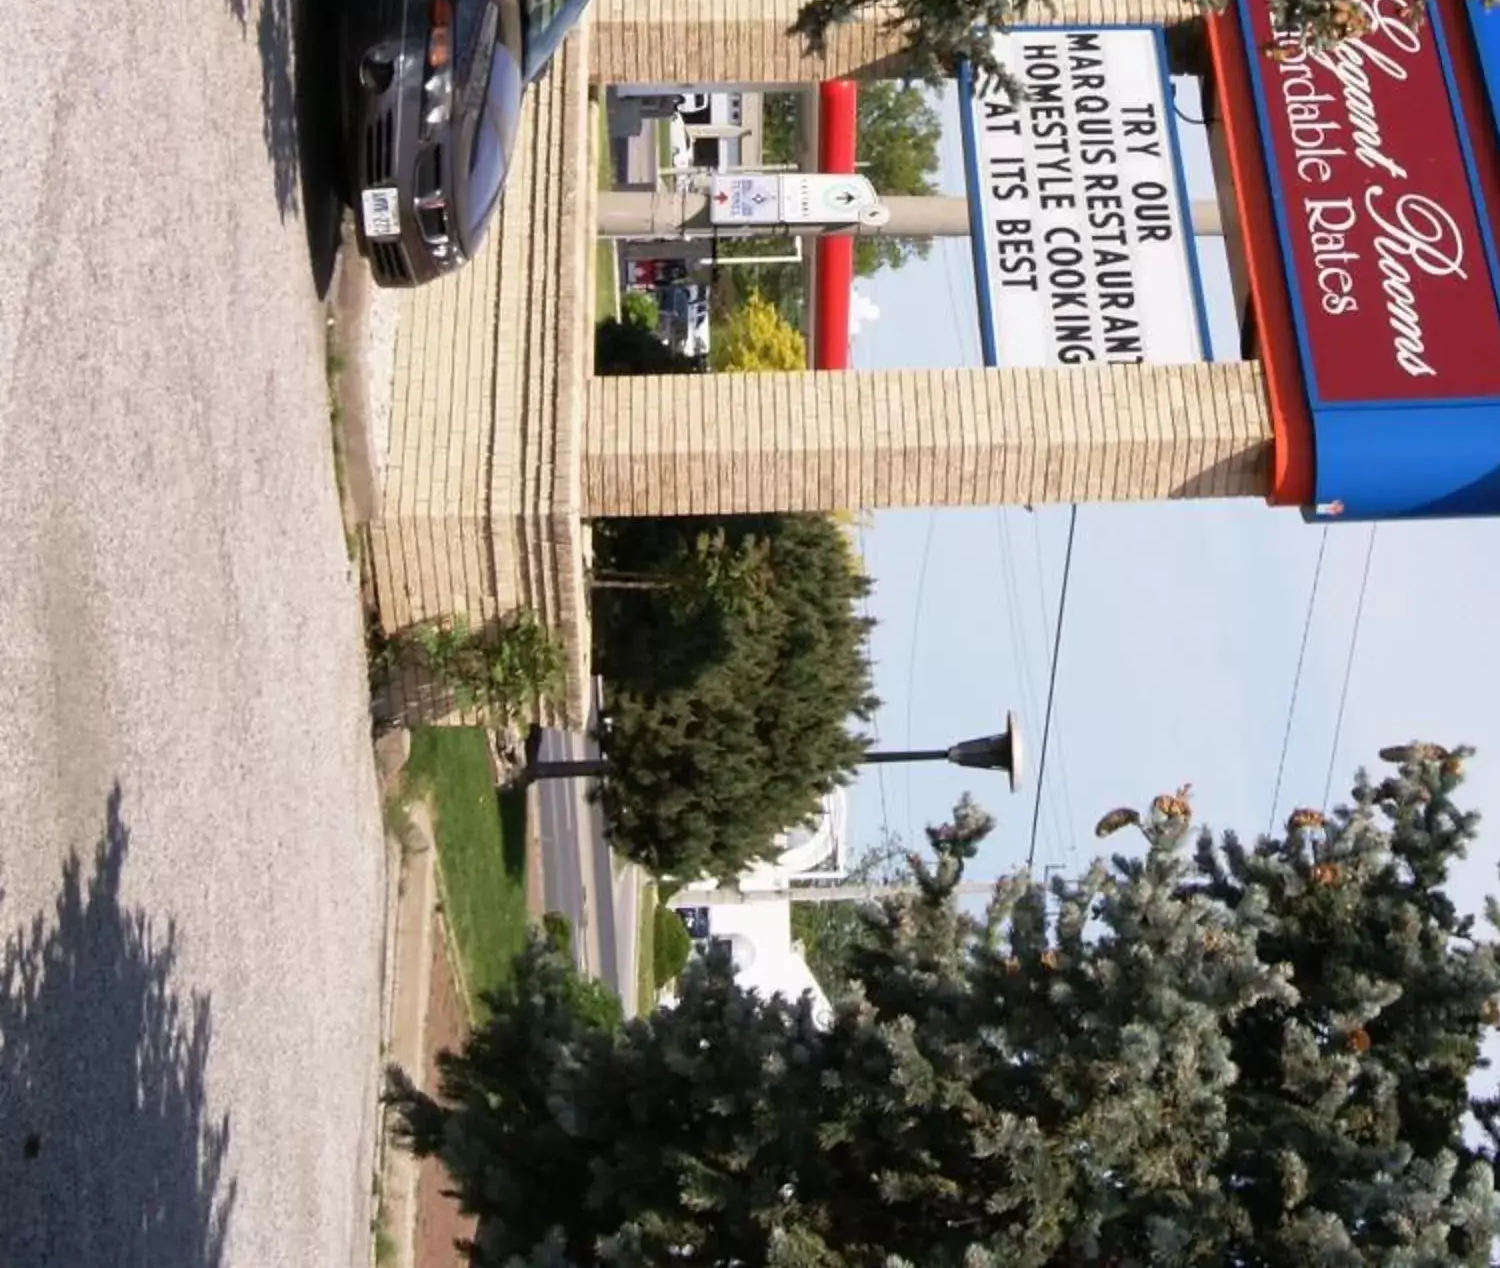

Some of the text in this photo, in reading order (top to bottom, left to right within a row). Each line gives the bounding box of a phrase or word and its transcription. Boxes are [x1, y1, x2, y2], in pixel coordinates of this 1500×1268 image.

[1066, 33, 1117, 164] MARQUIS
[1121, 104, 1172, 243] TRY OUR
[984, 101, 1038, 293] AT ITS BEST
[1023, 45, 1096, 364] HOMESTYLE COOKING
[1303, 198, 1360, 315] Rates
[1364, 185, 1468, 377] Rooms
